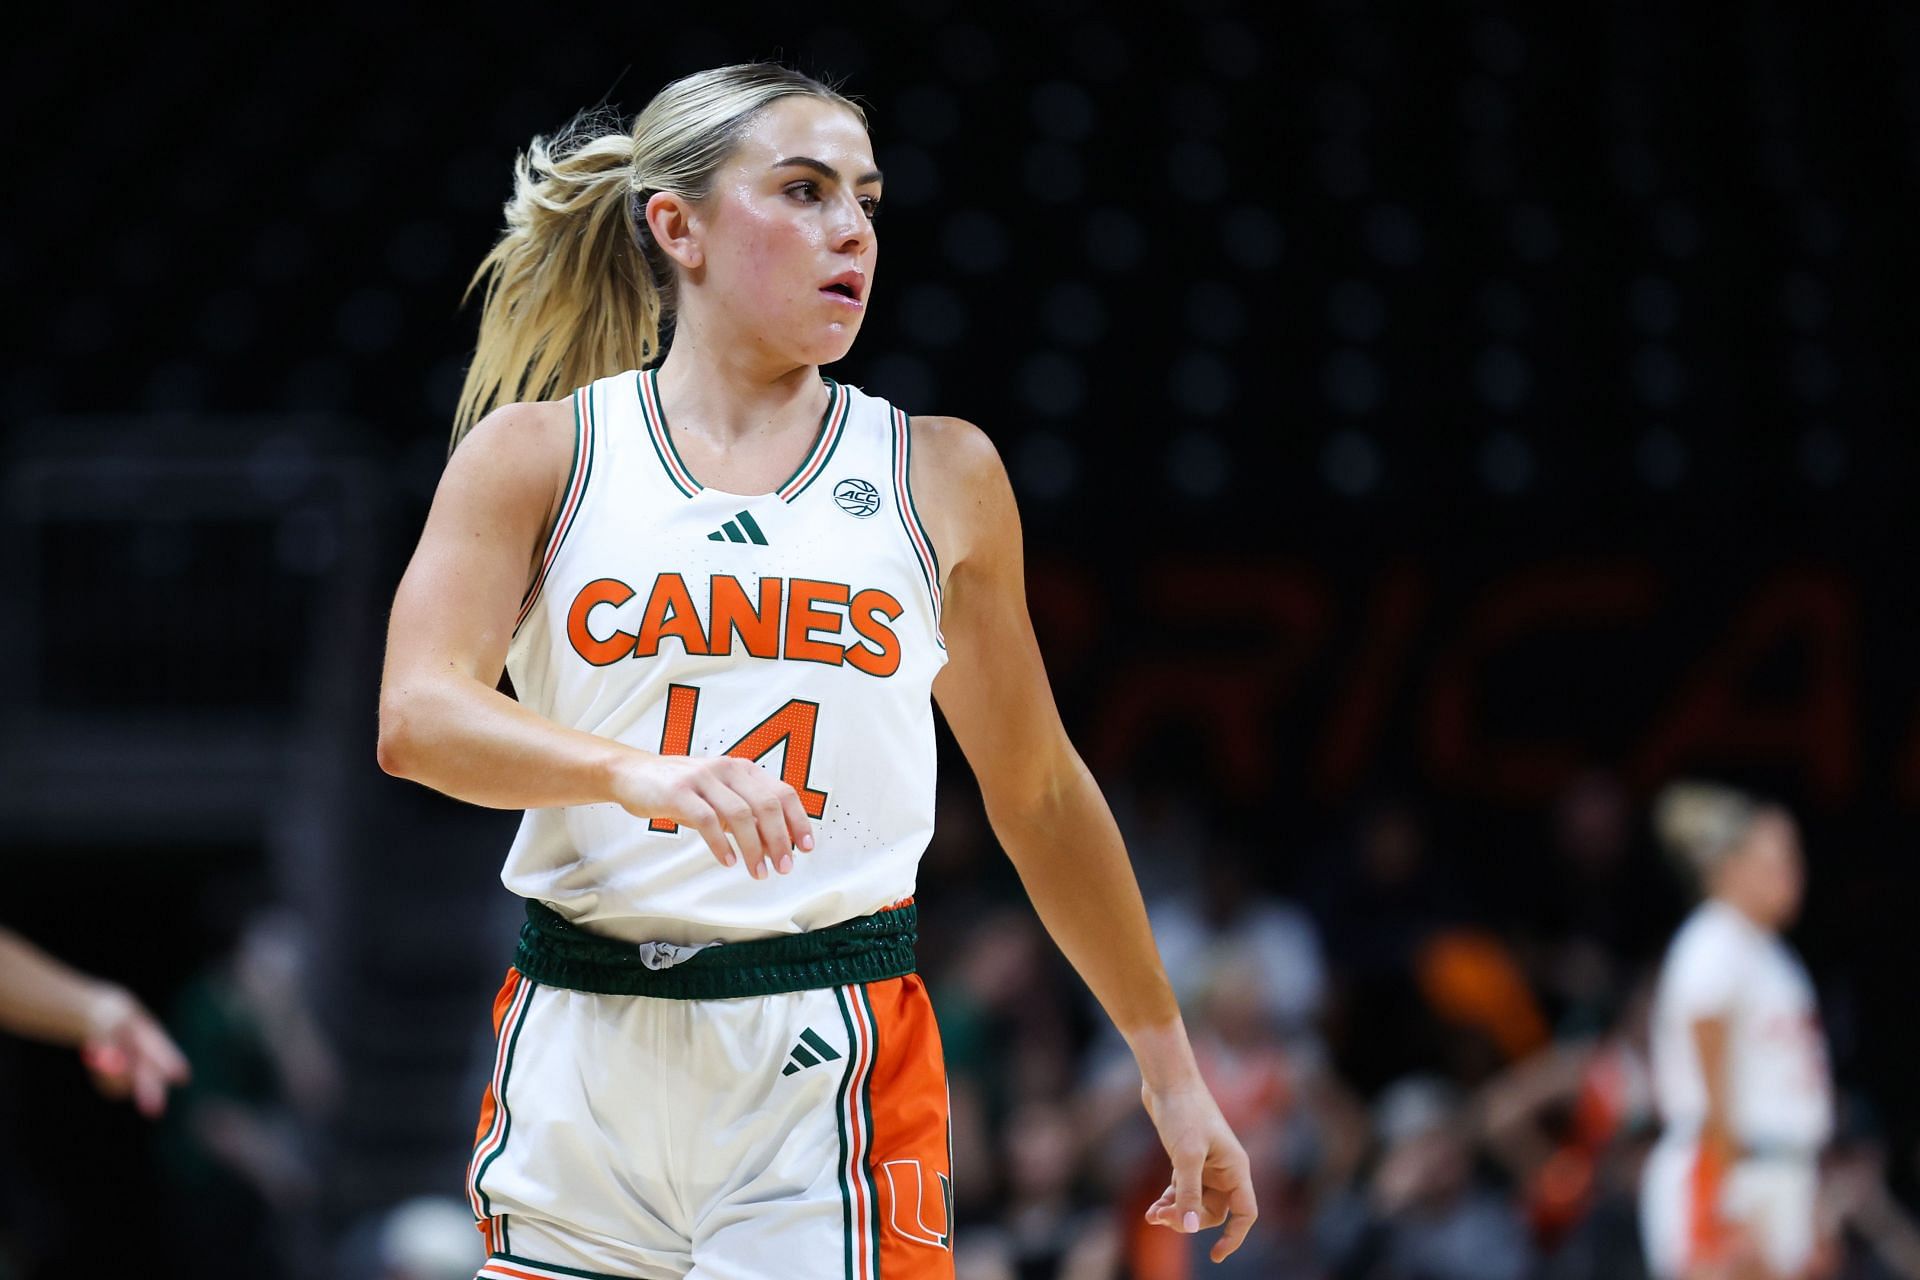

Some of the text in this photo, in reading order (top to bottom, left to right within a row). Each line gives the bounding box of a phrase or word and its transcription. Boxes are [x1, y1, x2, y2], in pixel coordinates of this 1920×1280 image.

[840, 490, 879, 504] ACC
[567, 573, 904, 677] CANES
[1022, 552, 1920, 804] RICA
[648, 683, 828, 851] 14
